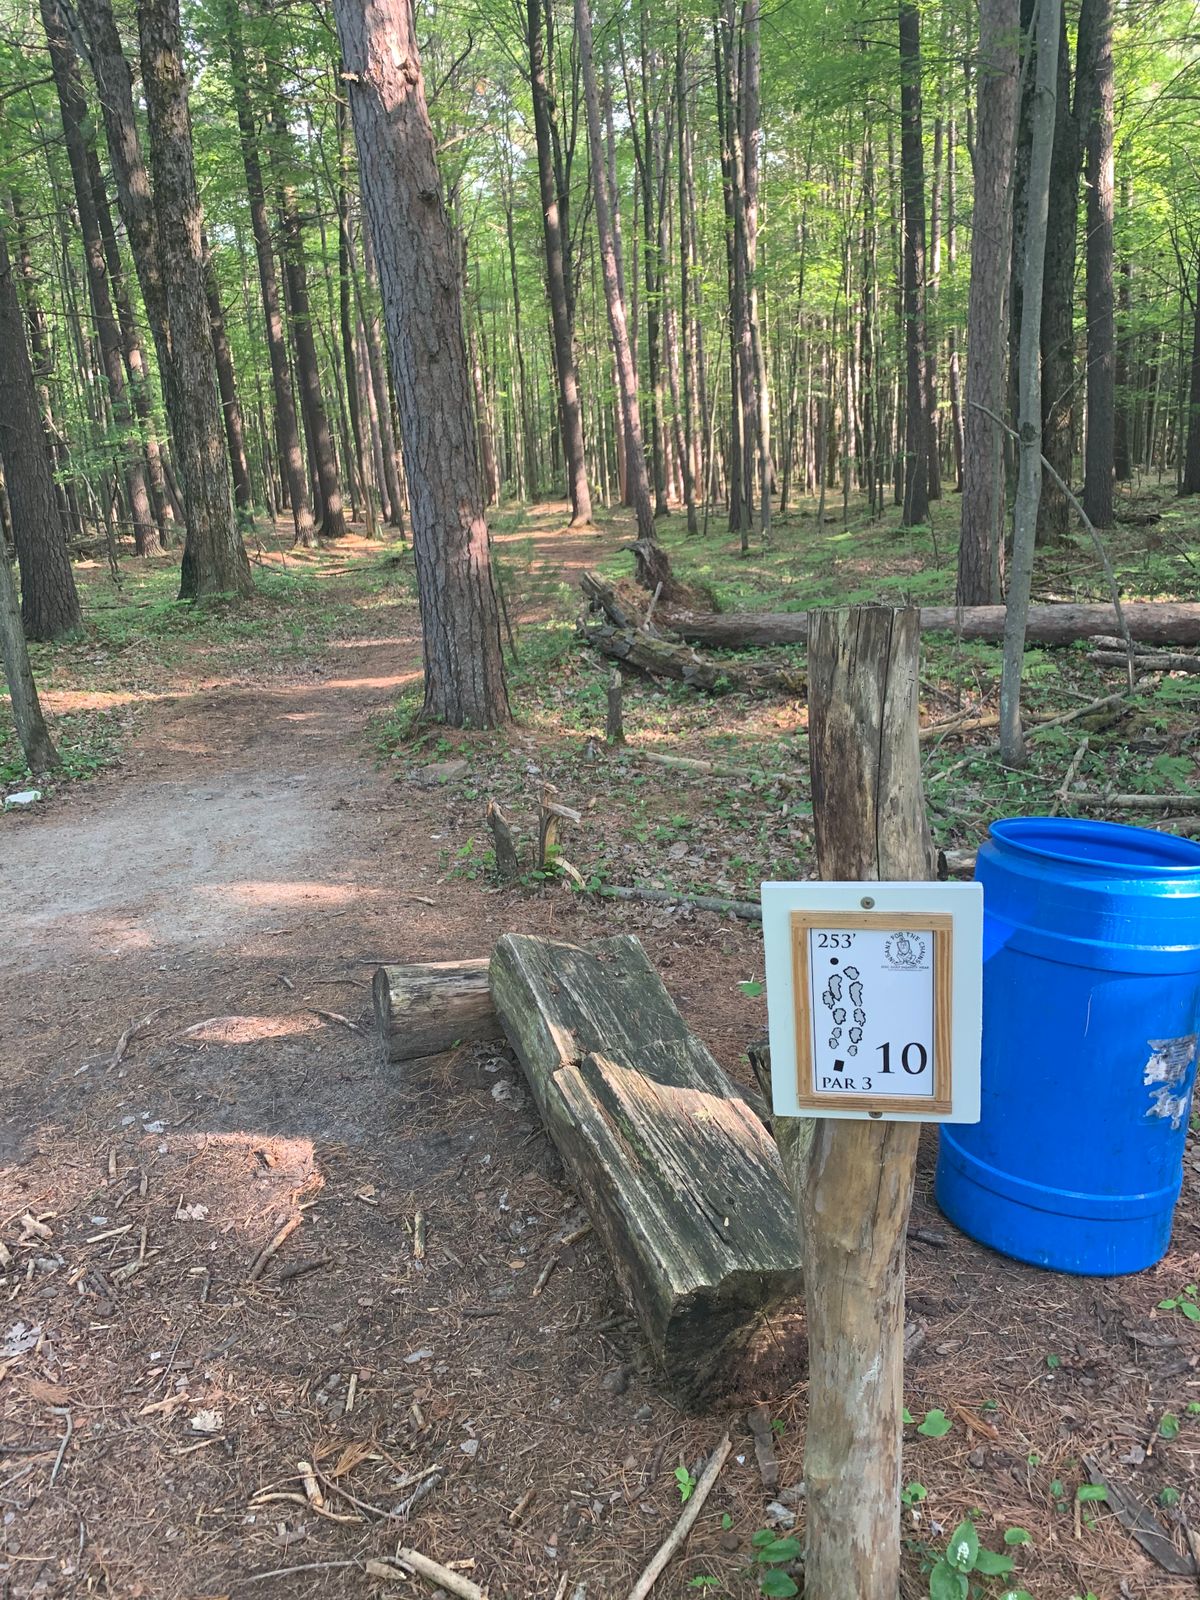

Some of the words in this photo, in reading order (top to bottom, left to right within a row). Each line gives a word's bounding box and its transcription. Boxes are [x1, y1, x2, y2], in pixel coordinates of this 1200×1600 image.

[818, 933, 856, 949] 253'
[890, 931, 904, 940] FOR
[906, 931, 921, 942] THE
[876, 1042, 927, 1075] 10
[822, 1077, 857, 1089] PAR
[862, 1076, 872, 1090] 3
